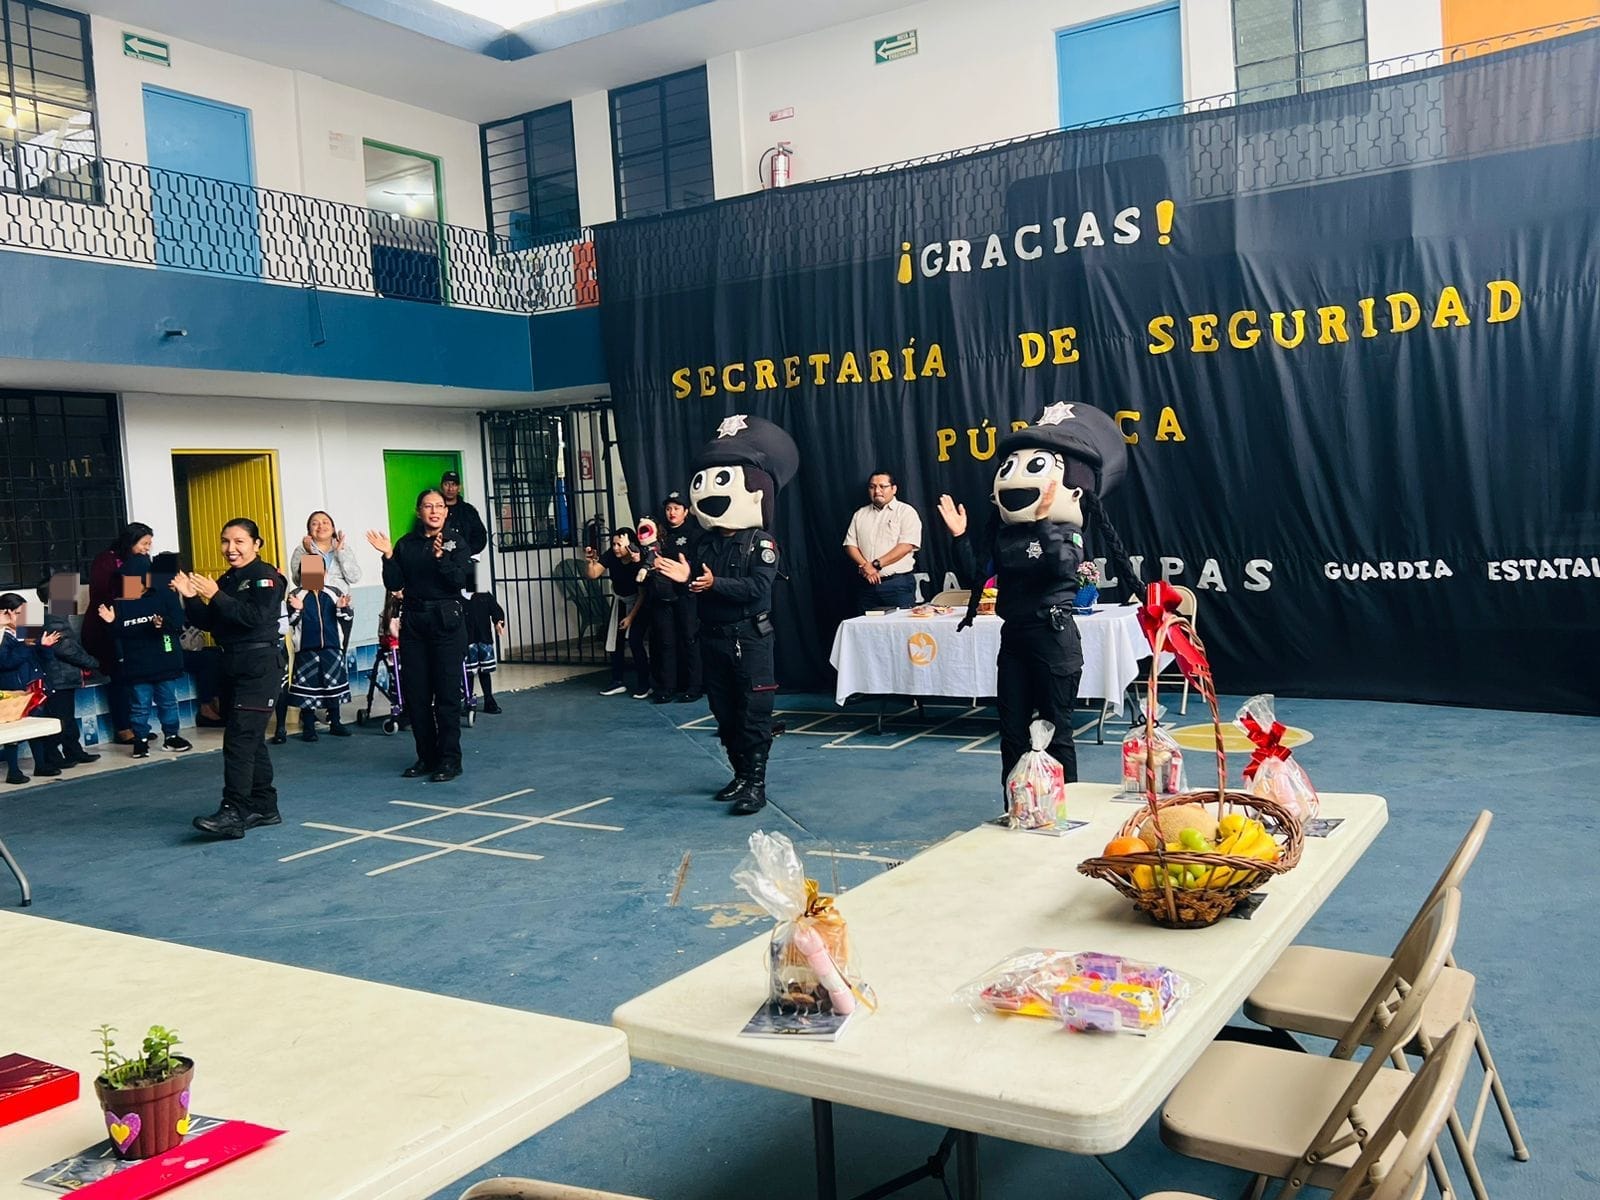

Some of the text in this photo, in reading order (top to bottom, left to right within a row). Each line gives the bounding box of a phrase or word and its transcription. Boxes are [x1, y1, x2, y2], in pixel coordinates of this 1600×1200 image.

[897, 199, 1176, 285] ¡GRACIAS!
[671, 279, 1522, 399] SECRETARÍA DE SEGURIDAD
[936, 405, 1187, 463] PÚCA
[1324, 558, 1454, 581] GUARDIA
